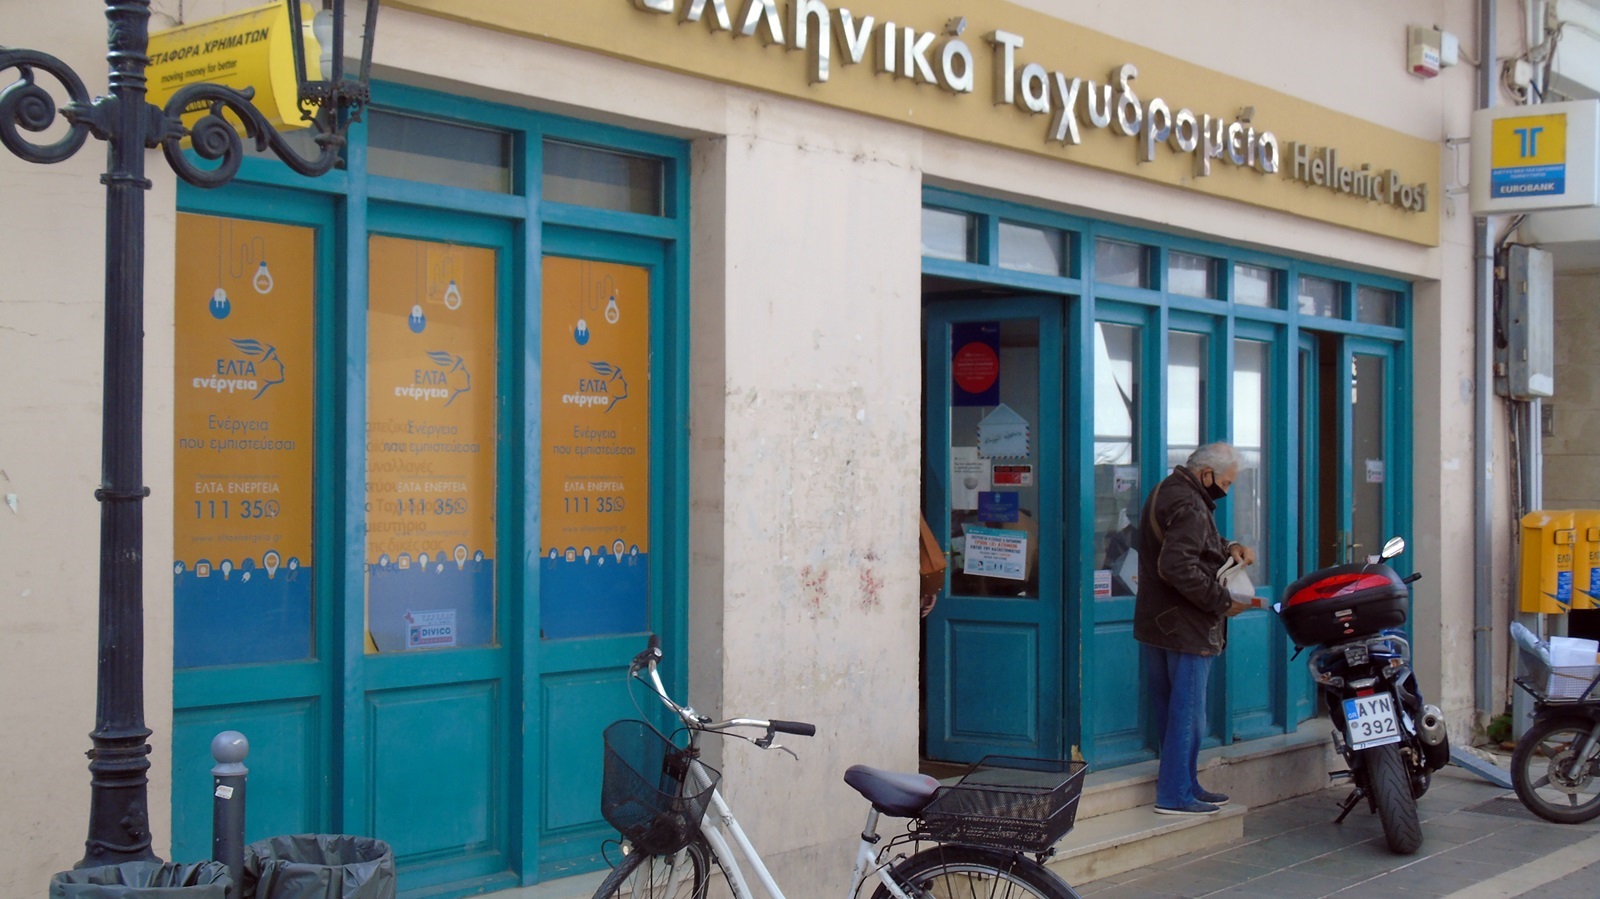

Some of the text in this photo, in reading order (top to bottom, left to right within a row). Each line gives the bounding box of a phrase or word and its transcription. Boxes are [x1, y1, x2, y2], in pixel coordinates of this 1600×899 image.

[148, 27, 270, 67] ΕΤΑΦΟΡΑ ΧΡΗΜΑΤΩΝ
[160, 59, 238, 84] moving money for better
[993, 29, 1279, 177] Ταχυδρομεία
[1292, 139, 1384, 202] Hellenic
[1499, 183, 1556, 194] EUROBANK
[192, 374, 258, 394] ενέργεια
[394, 384, 449, 401] ενέργεια
[562, 391, 609, 407] ενέργεια
[208, 414, 269, 435] Ενέργεια
[407, 419, 459, 439] Ενέργεια
[573, 425, 617, 442] Ενέργεια
[179, 435, 296, 453] που εμπιστεύεσαι
[409, 439, 481, 456] εμπιστεύεσαι
[553, 442, 636, 458] που εμπιστεύεσαι
[195, 481, 280, 493] ΕΛΤΑ ΕΝΕΡΓΕΙΑ
[397, 481, 468, 493] ΕΛΤΑ ΕΝΕΡΓΕΙΑ
[564, 481, 624, 492] ΕΛΤΑ ΕΝΕΡΓΕΙΑ
[194, 500, 264, 519] 111 35
[434, 498, 455, 515] 35
[564, 497, 613, 513] 111 35
[422, 627, 451, 637] DIVICO
[1358, 697, 1391, 718] AYN
[1361, 717, 1395, 737] 392
